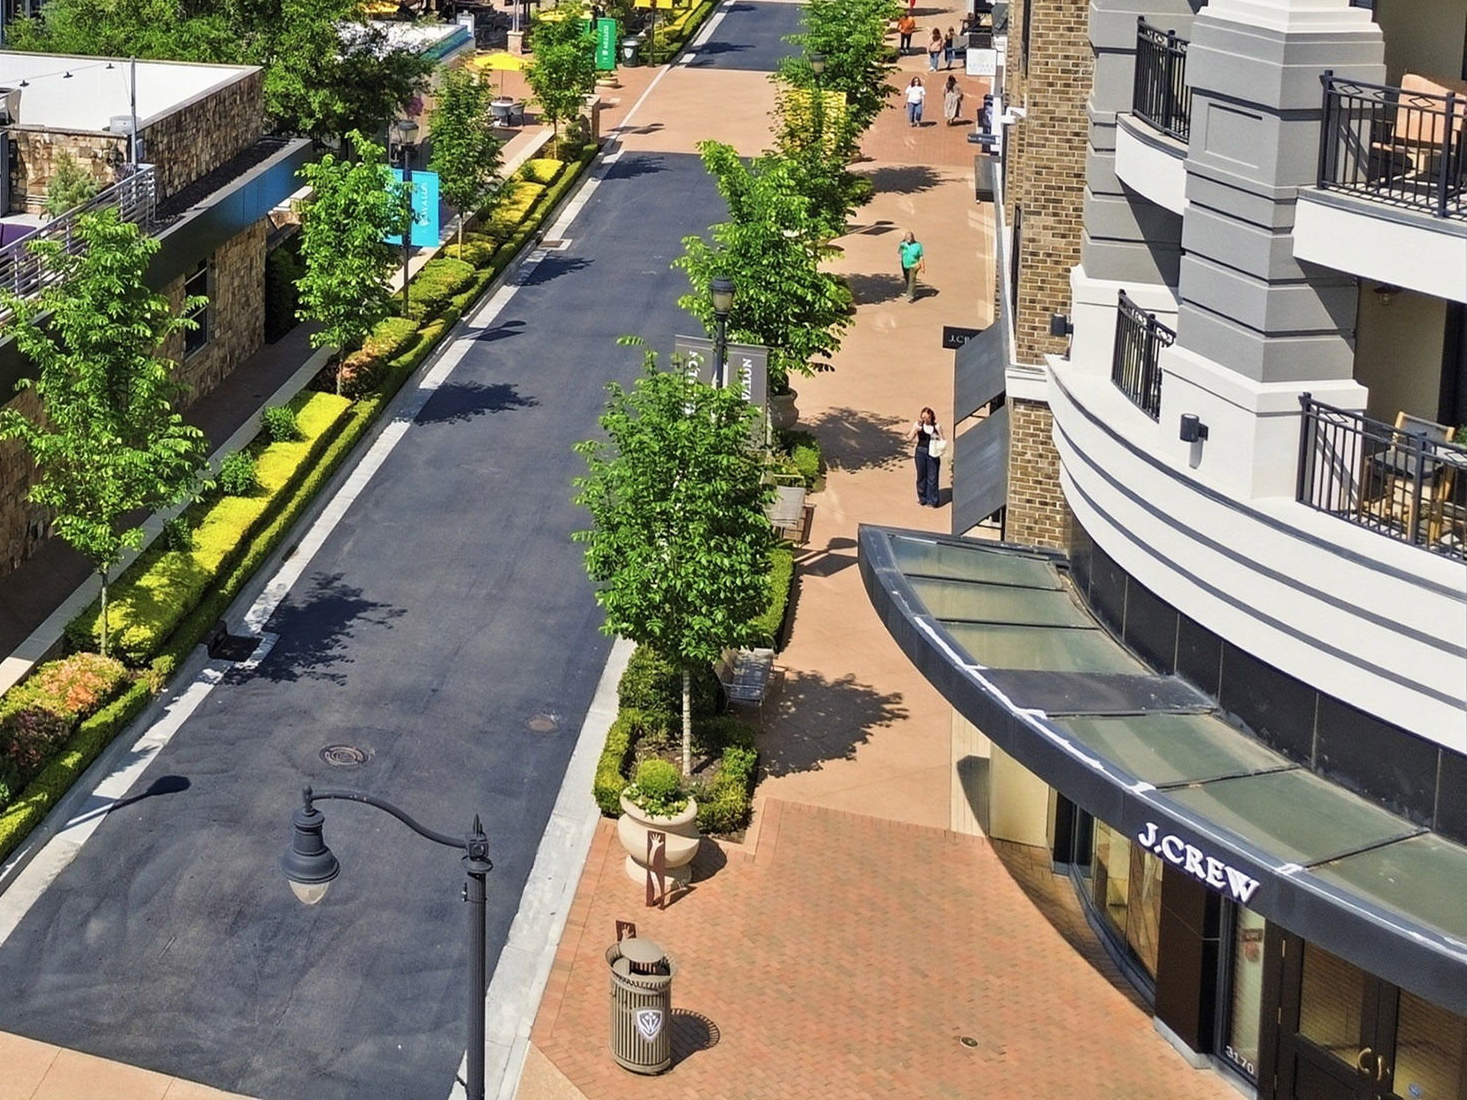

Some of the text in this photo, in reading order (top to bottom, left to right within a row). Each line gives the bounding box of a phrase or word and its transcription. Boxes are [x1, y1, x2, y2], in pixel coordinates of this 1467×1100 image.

[742, 358, 752, 404] VALON
[1138, 822, 1261, 903] J.CREW
[1226, 1045, 1255, 1075] 3170
